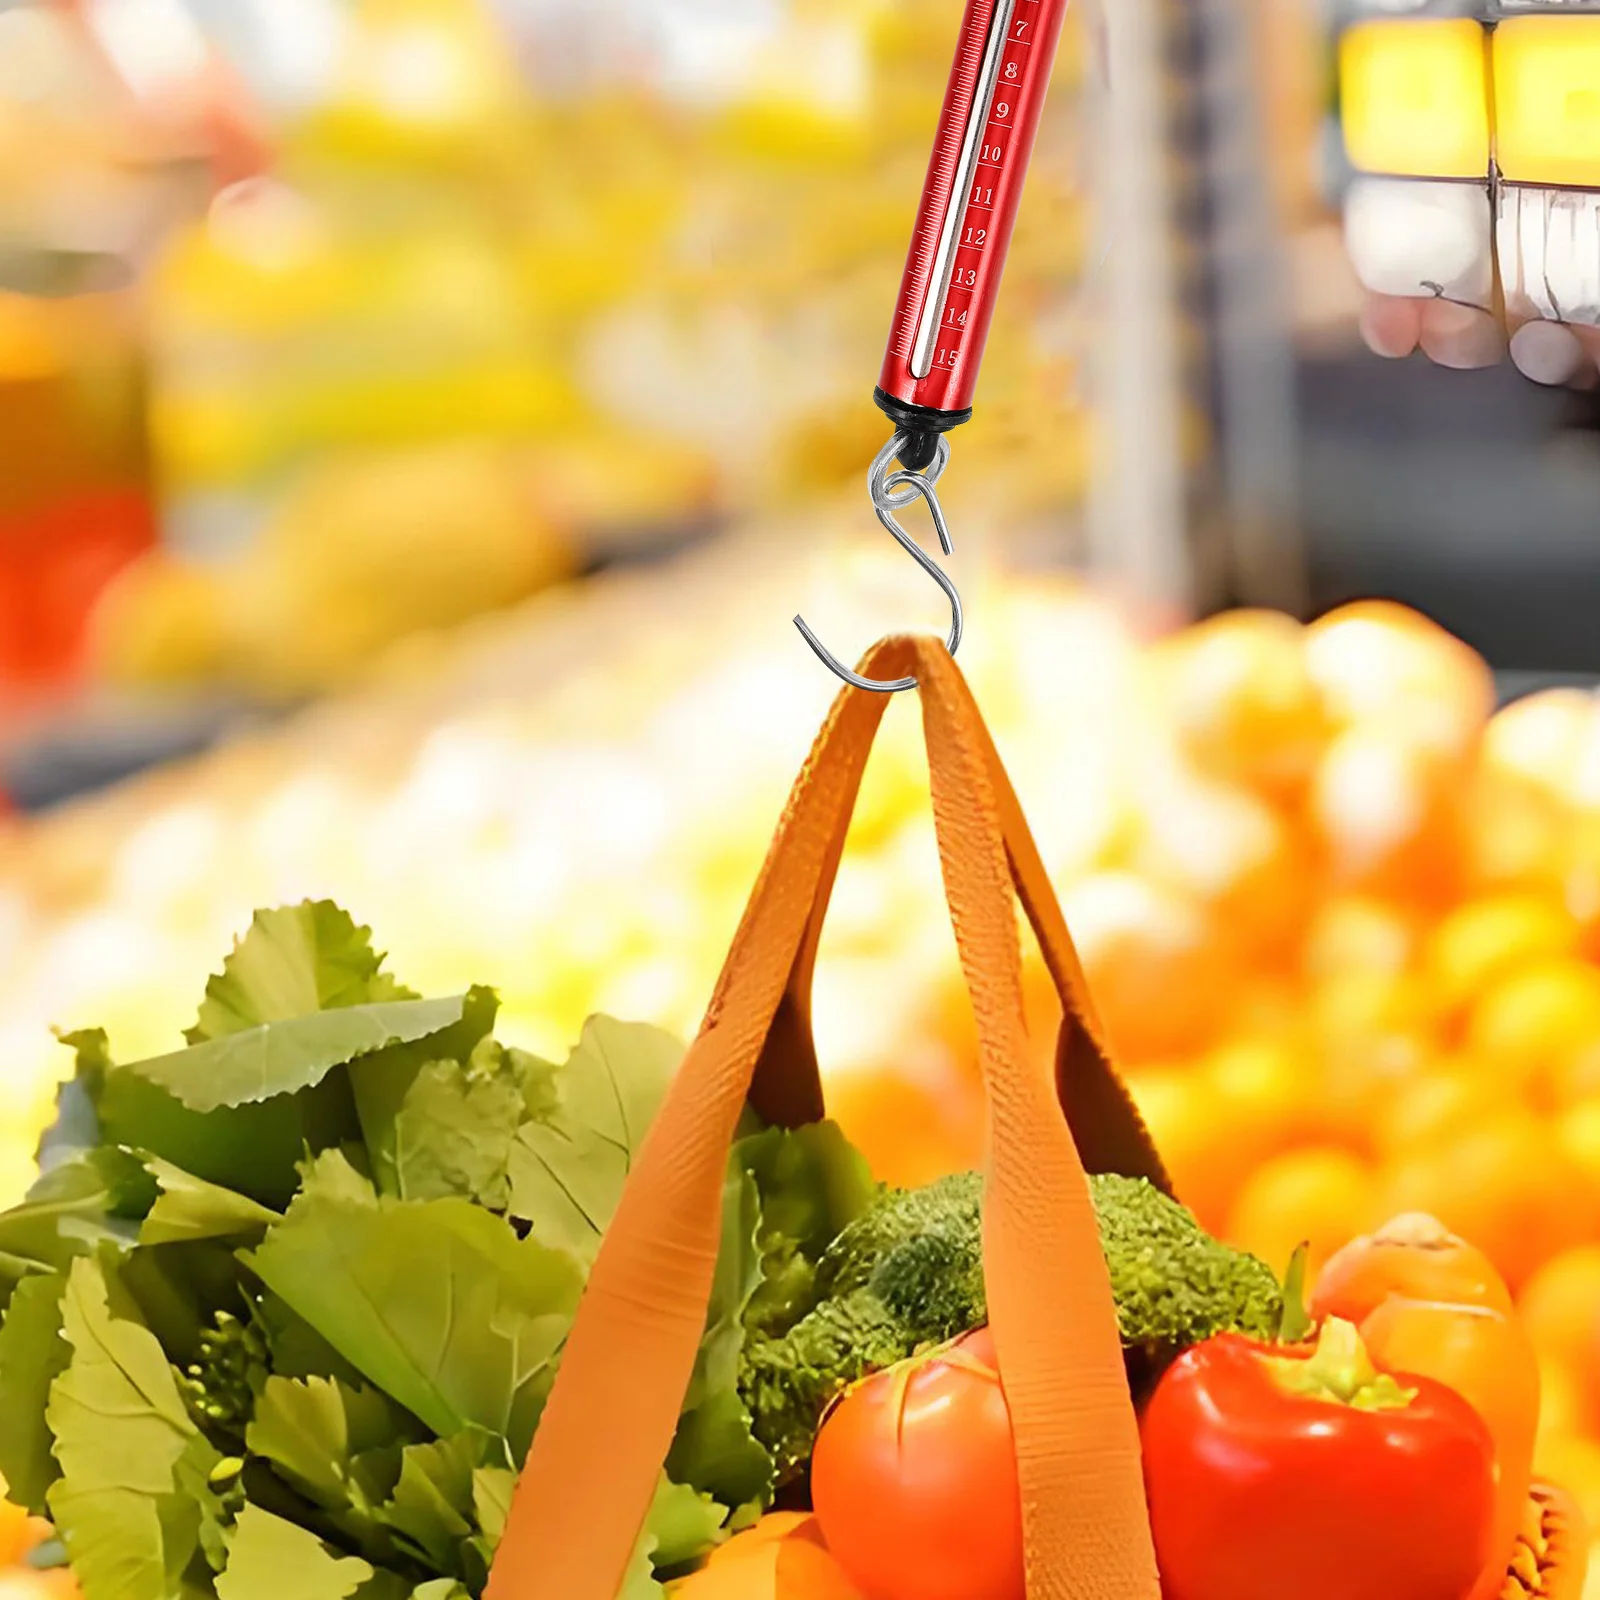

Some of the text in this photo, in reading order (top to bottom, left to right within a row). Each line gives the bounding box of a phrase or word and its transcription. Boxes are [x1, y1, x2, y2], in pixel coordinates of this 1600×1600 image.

[1016, 20, 1029, 37] 7
[1004, 62, 1018, 79] 8
[995, 102, 1010, 119] 9
[981, 144, 1001, 162] 10
[973, 186, 992, 205] 11
[964, 227, 986, 246] 12
[955, 267, 976, 286] 13
[946, 307, 969, 326] 14
[937, 348, 960, 367] 15
